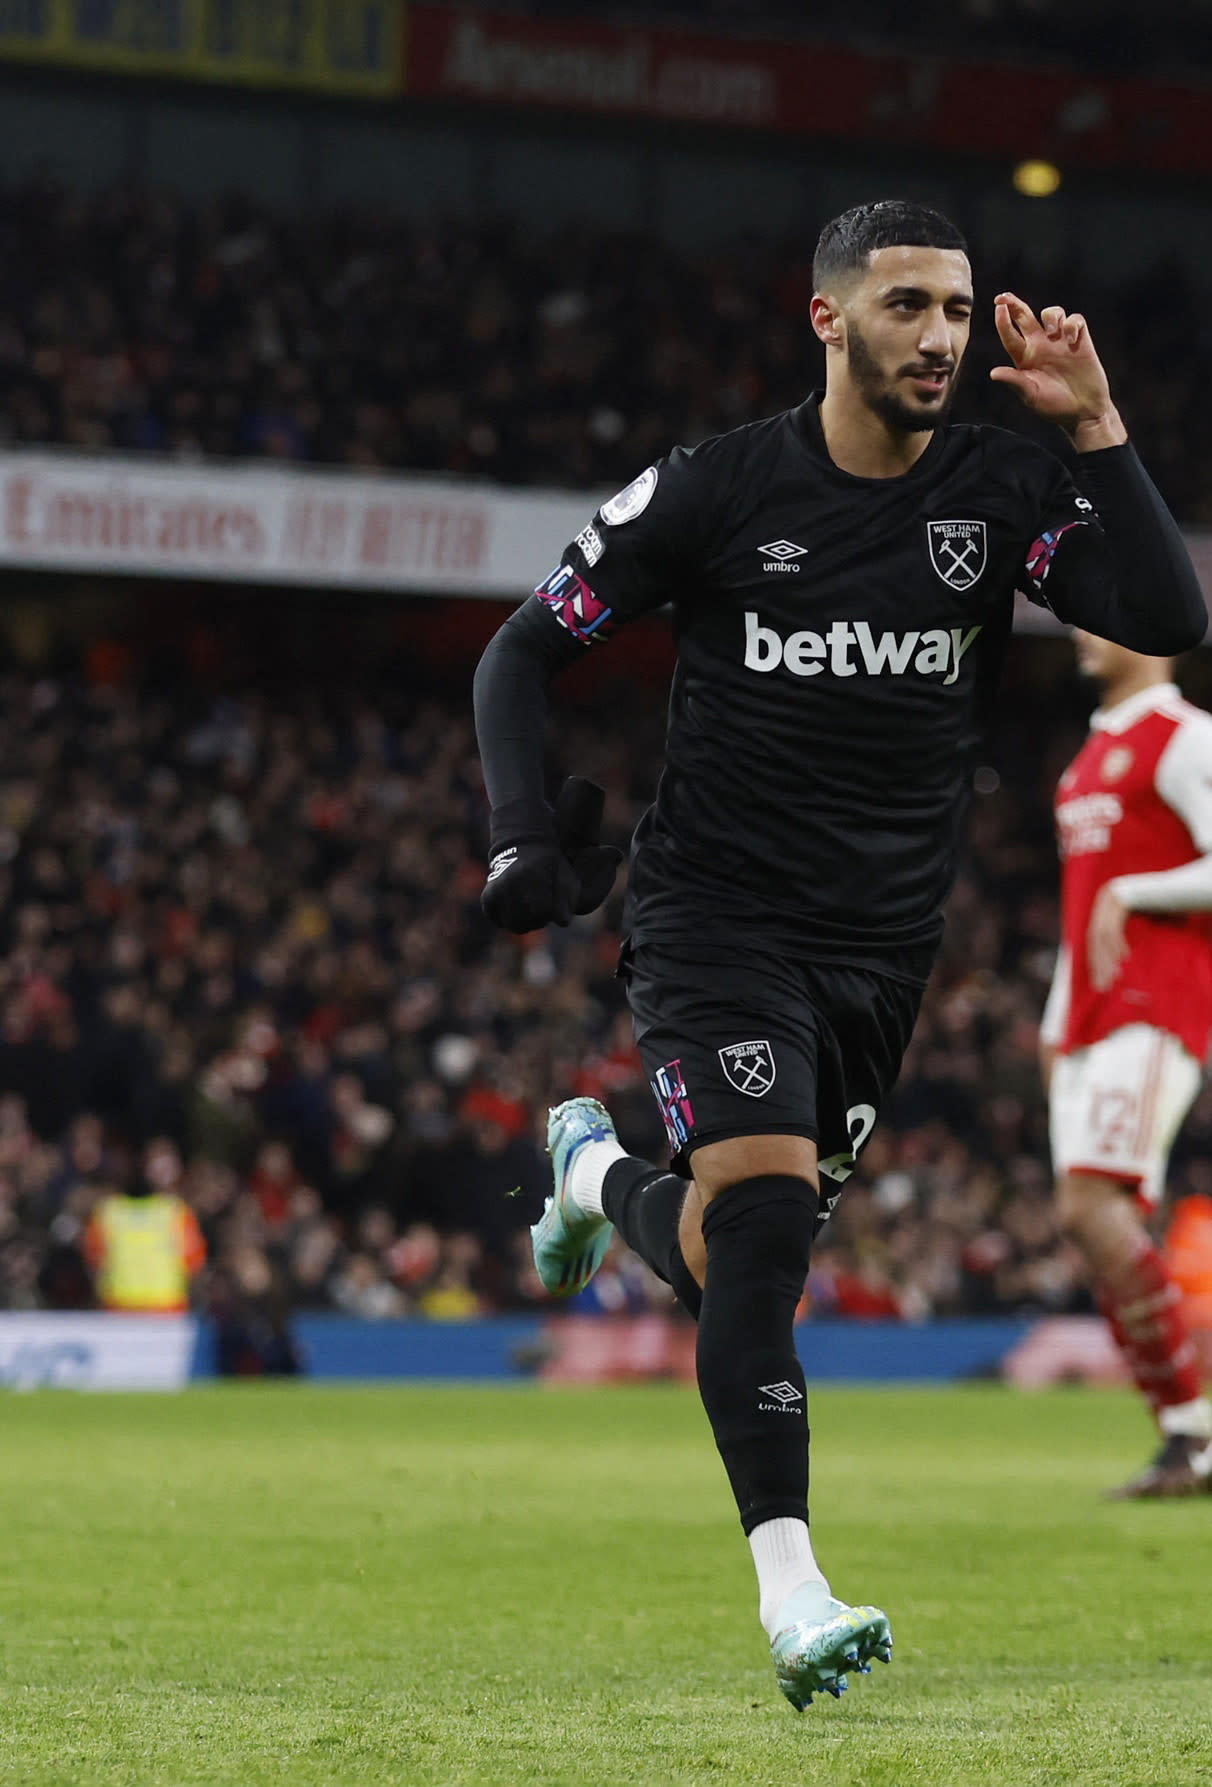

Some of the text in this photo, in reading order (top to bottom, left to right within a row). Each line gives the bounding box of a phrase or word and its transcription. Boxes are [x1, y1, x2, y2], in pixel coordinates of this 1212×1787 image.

[4, 468, 268, 560] Emirates
[933, 524, 981, 534] WEST HAM
[762, 560, 801, 573] umbro
[743, 611, 984, 686] betway
[758, 1402, 803, 1415] umbro
